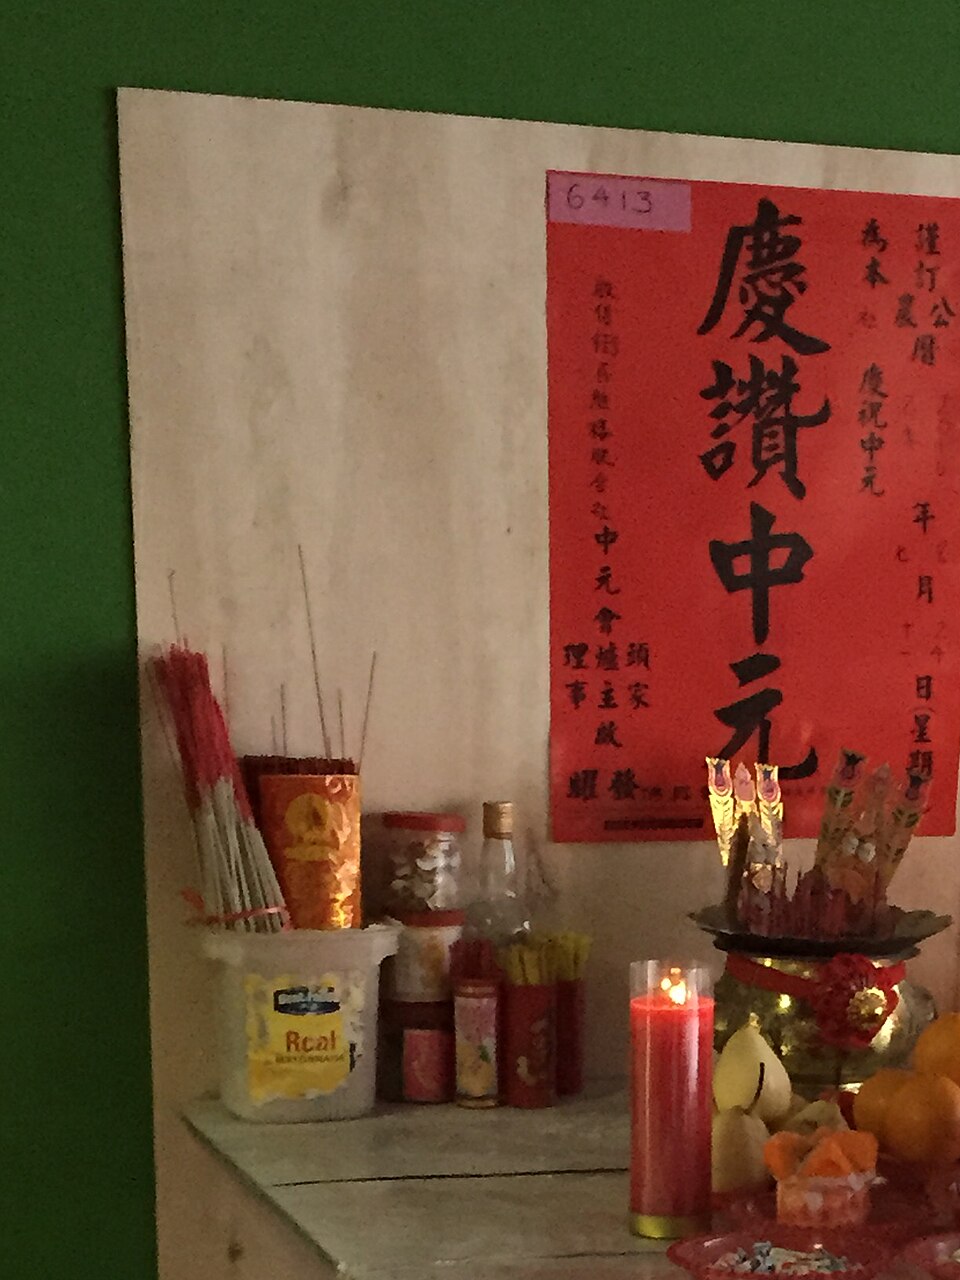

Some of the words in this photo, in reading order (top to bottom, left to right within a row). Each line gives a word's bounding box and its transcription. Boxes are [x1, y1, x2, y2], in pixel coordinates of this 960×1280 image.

[566, 183, 653, 214] 6413
[697, 197, 832, 781] 慶讚中元
[912, 503, 935, 533] 年
[916, 575, 934, 603] 月
